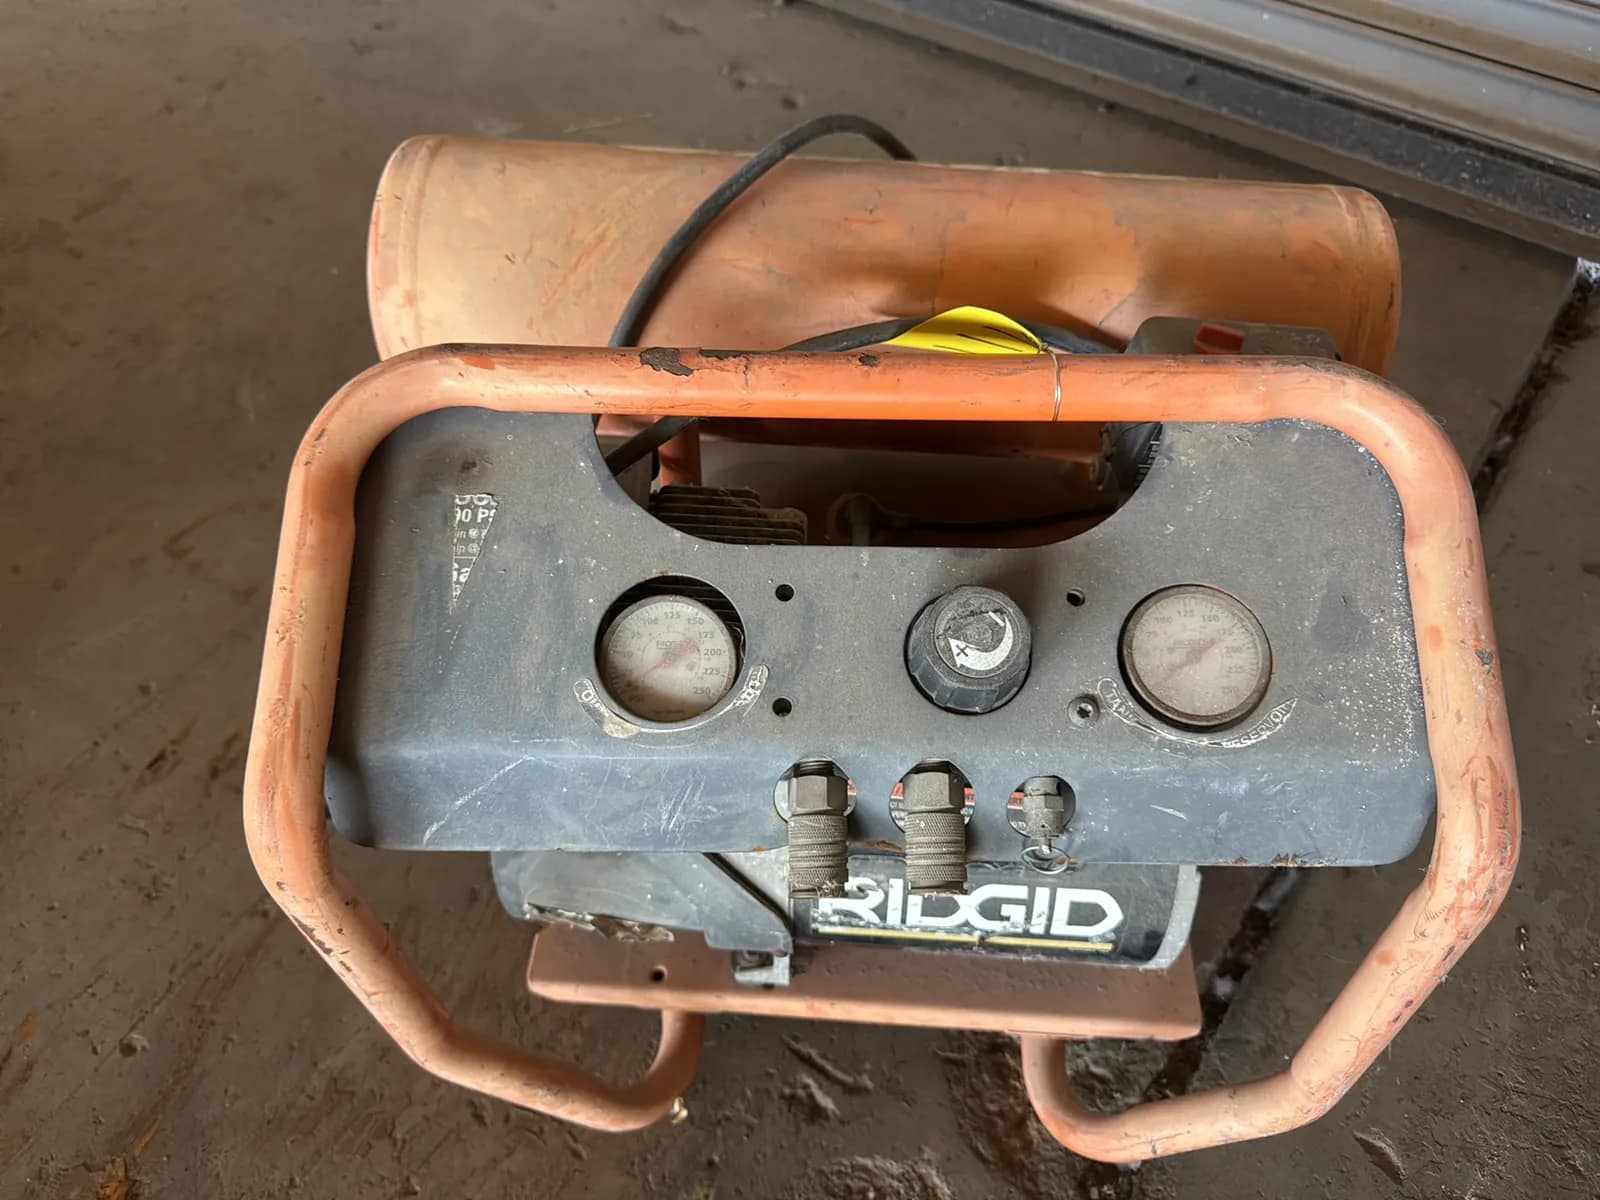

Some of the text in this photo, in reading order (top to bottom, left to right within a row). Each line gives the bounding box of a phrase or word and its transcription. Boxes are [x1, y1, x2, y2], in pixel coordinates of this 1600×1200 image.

[664, 611, 681, 620] 125
[643, 617, 659, 626] 100
[687, 617, 705, 626] 150
[699, 631, 714, 640] 175
[703, 648, 722, 657] 200
[703, 667, 721, 676] 225
[693, 686, 712, 696] 250
[818, 876, 1124, 937] RIDGID
